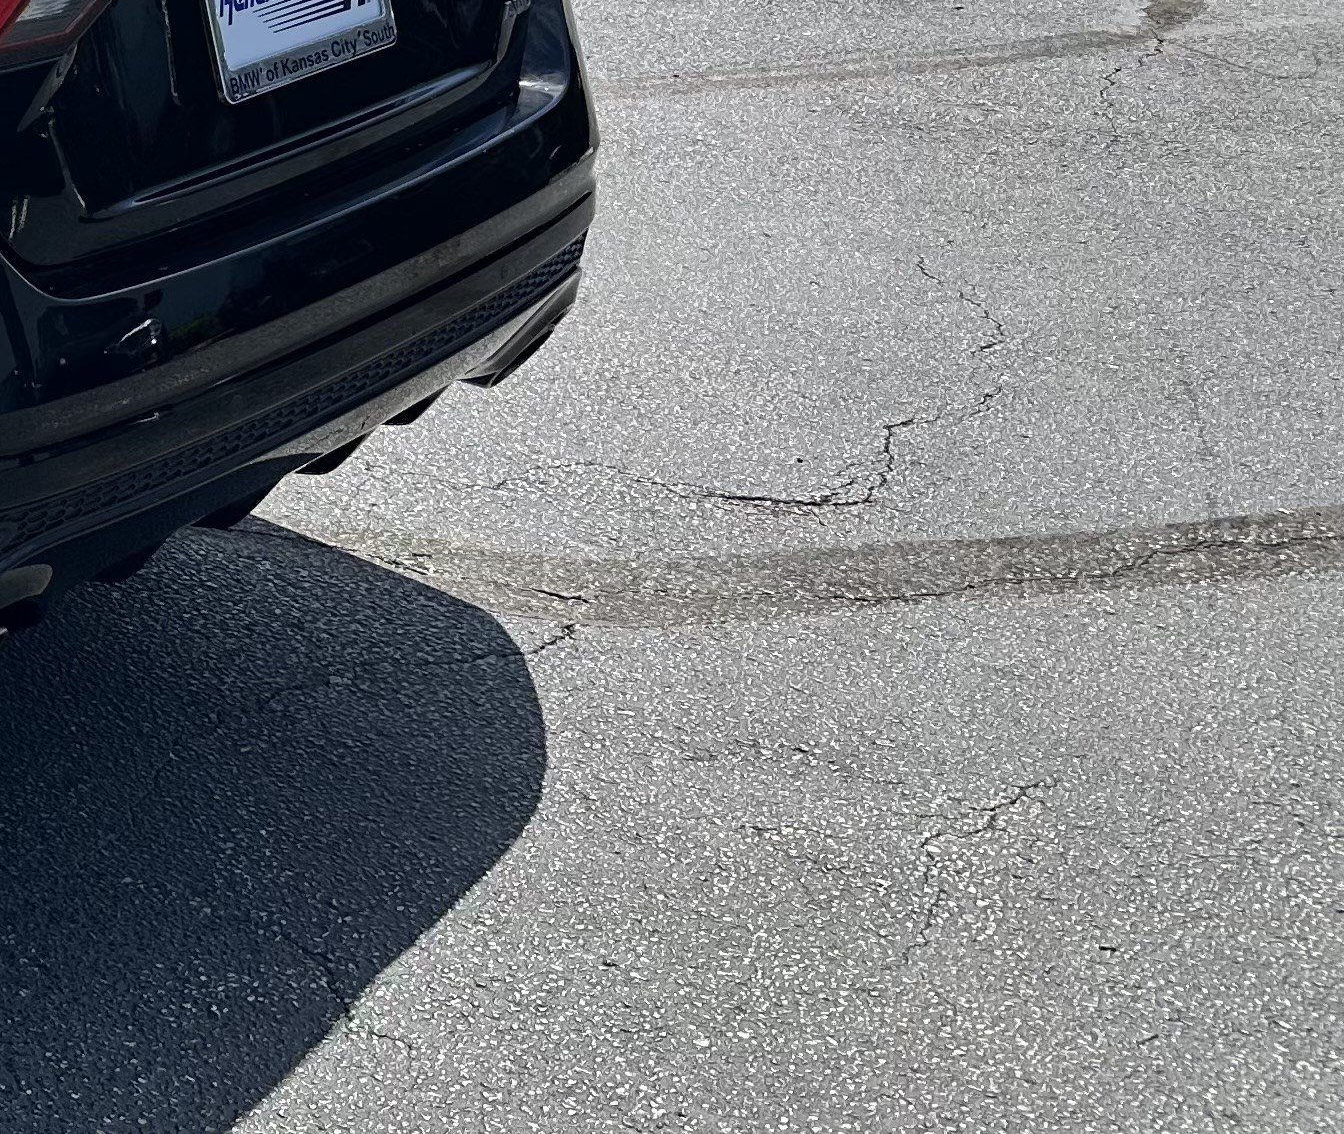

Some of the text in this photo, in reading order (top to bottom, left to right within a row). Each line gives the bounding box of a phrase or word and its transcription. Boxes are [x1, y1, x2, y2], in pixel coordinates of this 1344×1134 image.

[266, 61, 279, 82] of
[280, 48, 329, 77] Kansas
[362, 20, 396, 47] South
